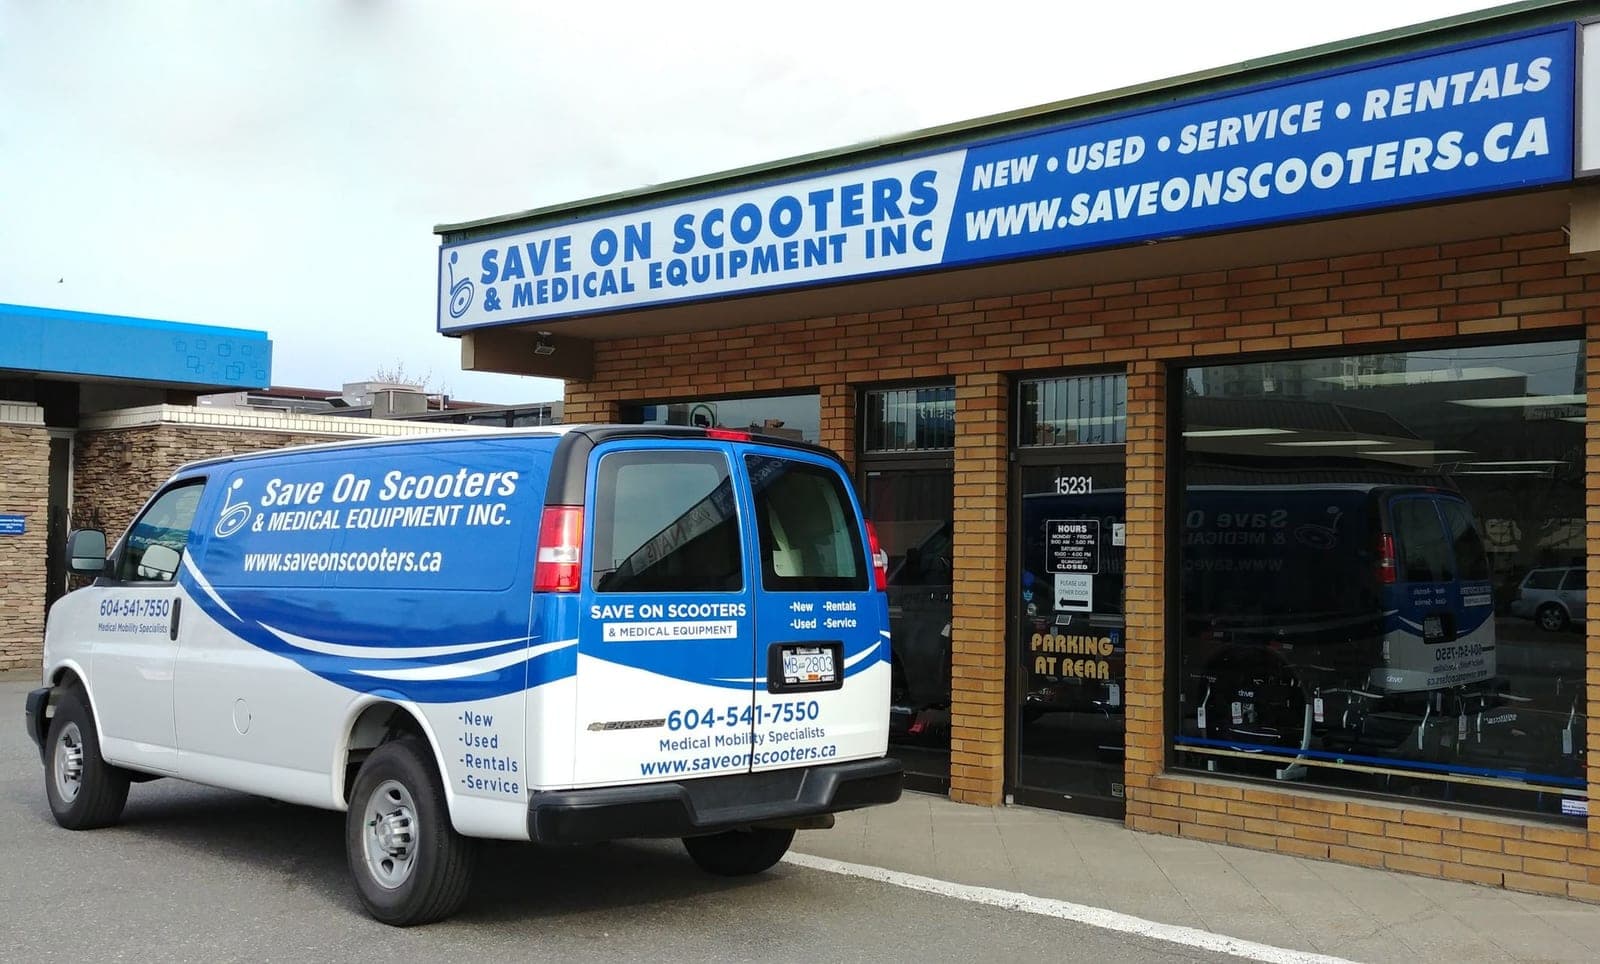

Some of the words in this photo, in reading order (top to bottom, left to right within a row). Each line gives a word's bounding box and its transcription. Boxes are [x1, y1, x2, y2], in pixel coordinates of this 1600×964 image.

[971, 154, 1039, 192] NEW
[1065, 134, 1146, 175] USED
[1179, 101, 1323, 156] SERVICE
[1362, 56, 1553, 123] RENTALS
[964, 116, 1551, 242] WWW.SAVEONSCOOTERS.CA
[480, 235, 571, 285] SAVE
[590, 221, 652, 267] ON
[672, 168, 939, 255] SCOOTERS
[482, 286, 503, 313] &
[511, 266, 635, 309] MEDICAL
[648, 234, 847, 288] EQUIPMENT
[864, 219, 933, 260] INC
[260, 478, 325, 507] Save
[331, 472, 371, 503] On
[378, 467, 520, 501] Scooters
[1054, 476, 1093, 495] 15231
[251, 512, 263, 532] &
[267, 507, 341, 532] MEDICAL
[345, 504, 462, 531] EQUIPMENT
[466, 503, 512, 526] INC.
[1057, 524, 1087, 533] HOURS
[243, 548, 442, 573] www.saveonscooters.ca
[99, 599, 169, 617] 604-541-7550
[591, 604, 635, 620] SAVE
[639, 604, 664, 619] ON
[668, 602, 746, 618] SCOOTERS
[98, 622, 117, 632] Medical
[117, 623, 138, 634] Mobility
[138, 622, 168, 633] Specialists
[608, 627, 617, 638] &
[619, 625, 670, 637] MEDICAL
[672, 623, 734, 637] EQUIPMENT
[1031, 632, 1114, 657] PARKING
[1035, 655, 1057, 675] AT
[1062, 657, 1109, 680] REAR
[458, 710, 493, 727] -New
[667, 700, 820, 731] 604-541-7550
[459, 731, 498, 749] -Used
[659, 735, 711, 753] Medical
[714, 731, 765, 750] Mobility
[768, 726, 826, 746] Specialists
[459, 753, 518, 772] -Rentals
[640, 743, 837, 776] www.saveonscooters.ca
[461, 774, 519, 793] -Service
